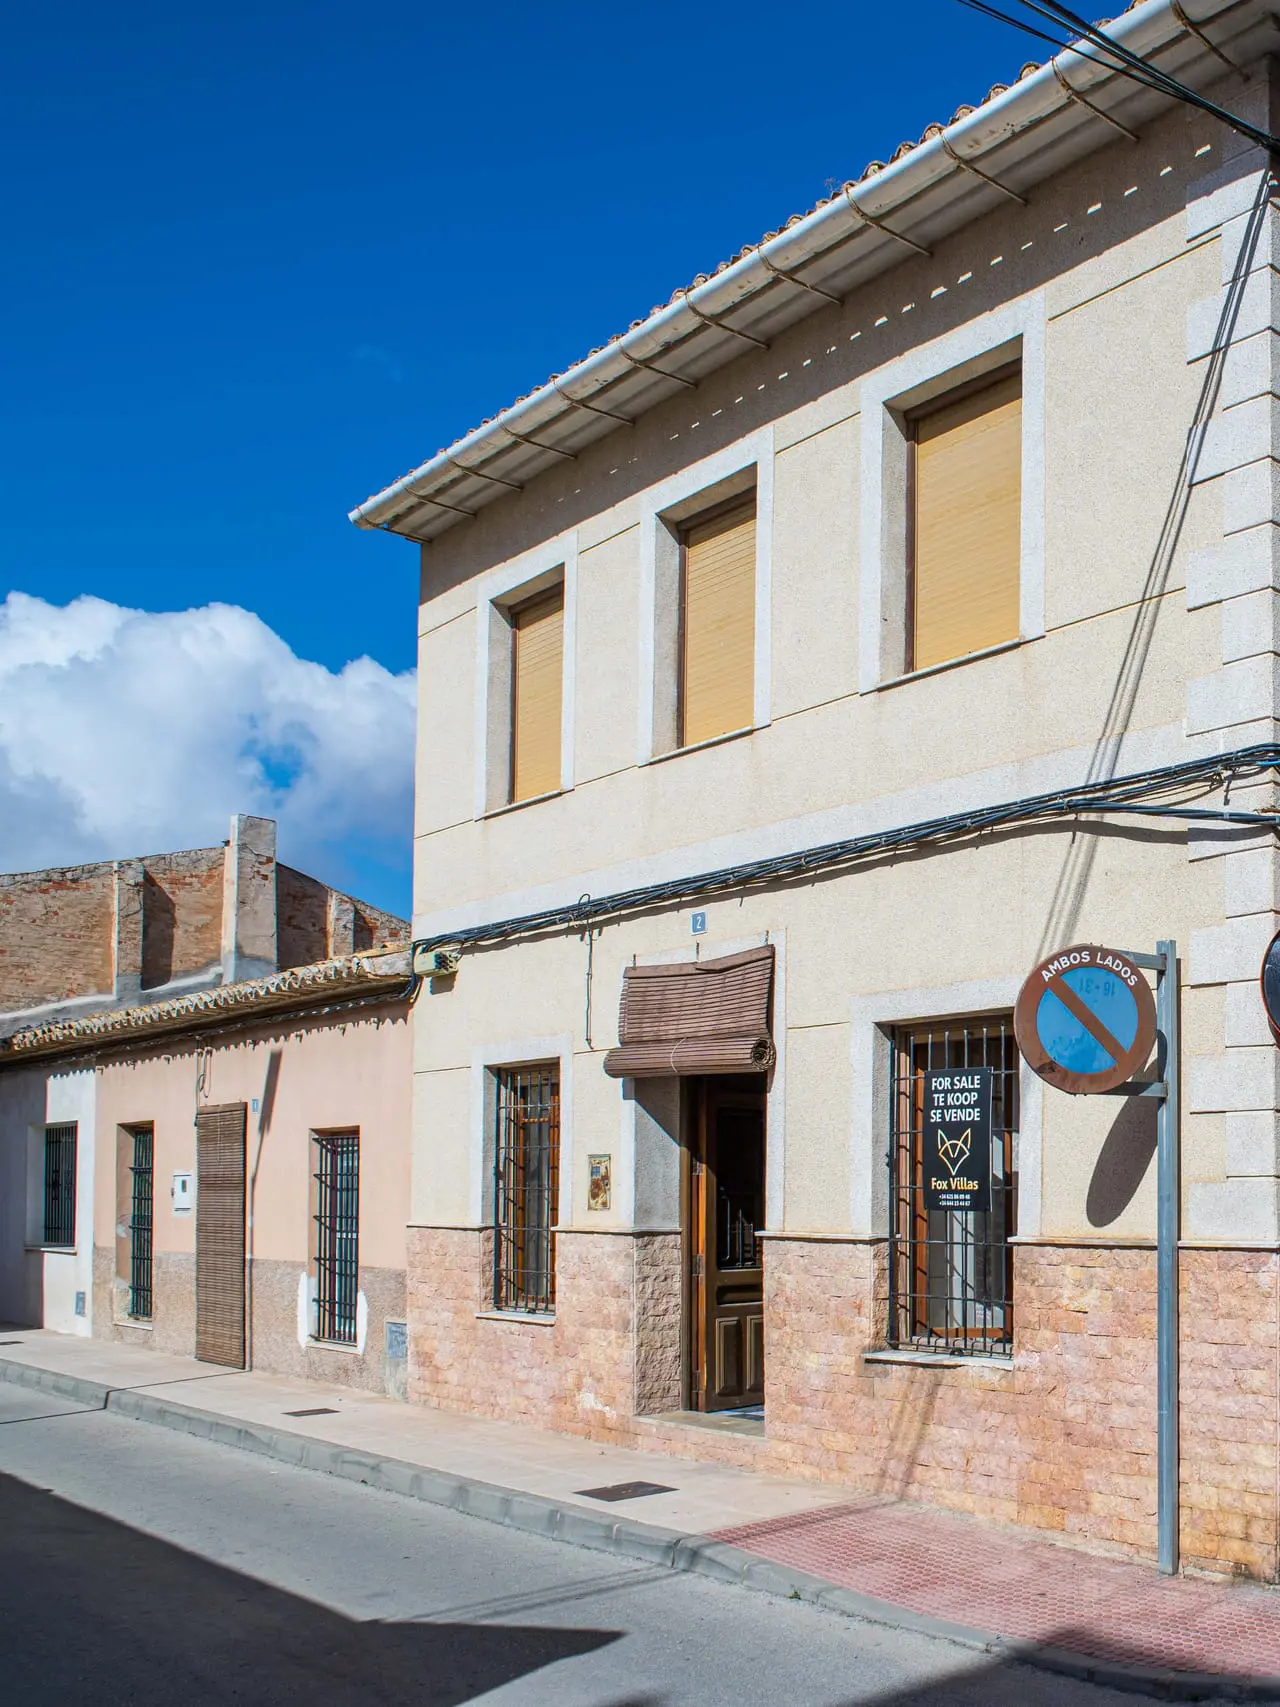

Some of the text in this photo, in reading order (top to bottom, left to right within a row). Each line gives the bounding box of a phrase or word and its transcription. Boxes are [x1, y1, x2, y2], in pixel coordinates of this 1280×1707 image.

[697, 916, 701, 928] 2
[1041, 951, 1138, 986] AMBOS LADOS
[931, 1075, 981, 1090] FOR SALE
[932, 1091, 978, 1106] TE KOOP
[930, 1107, 981, 1122] SE VENDE
[931, 1176, 979, 1190] Fox Villas
